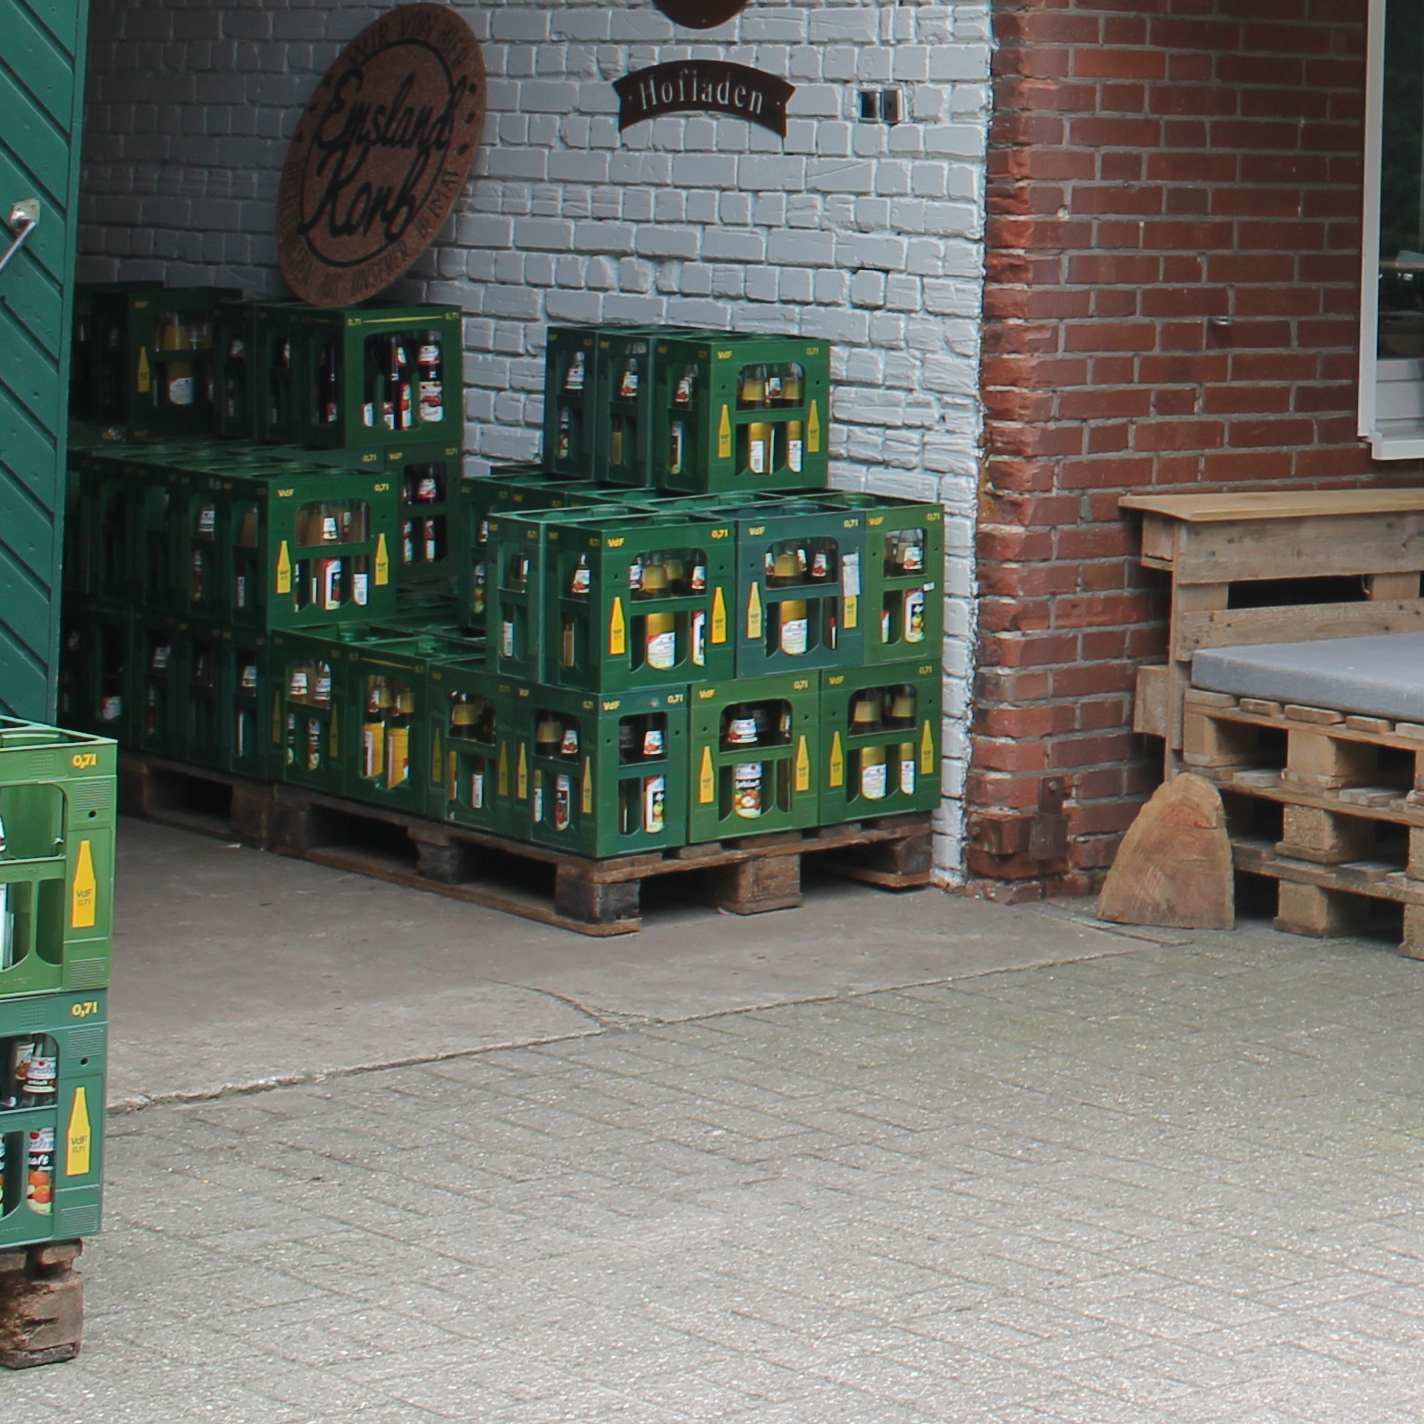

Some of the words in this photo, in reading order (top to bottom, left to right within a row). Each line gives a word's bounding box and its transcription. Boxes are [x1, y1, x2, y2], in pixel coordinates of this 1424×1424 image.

[313, 67, 468, 151] Emsland
[640, 68, 763, 114] Hofladen
[296, 142, 429, 244] Korb
[415, 169, 461, 240] HEIMAT
